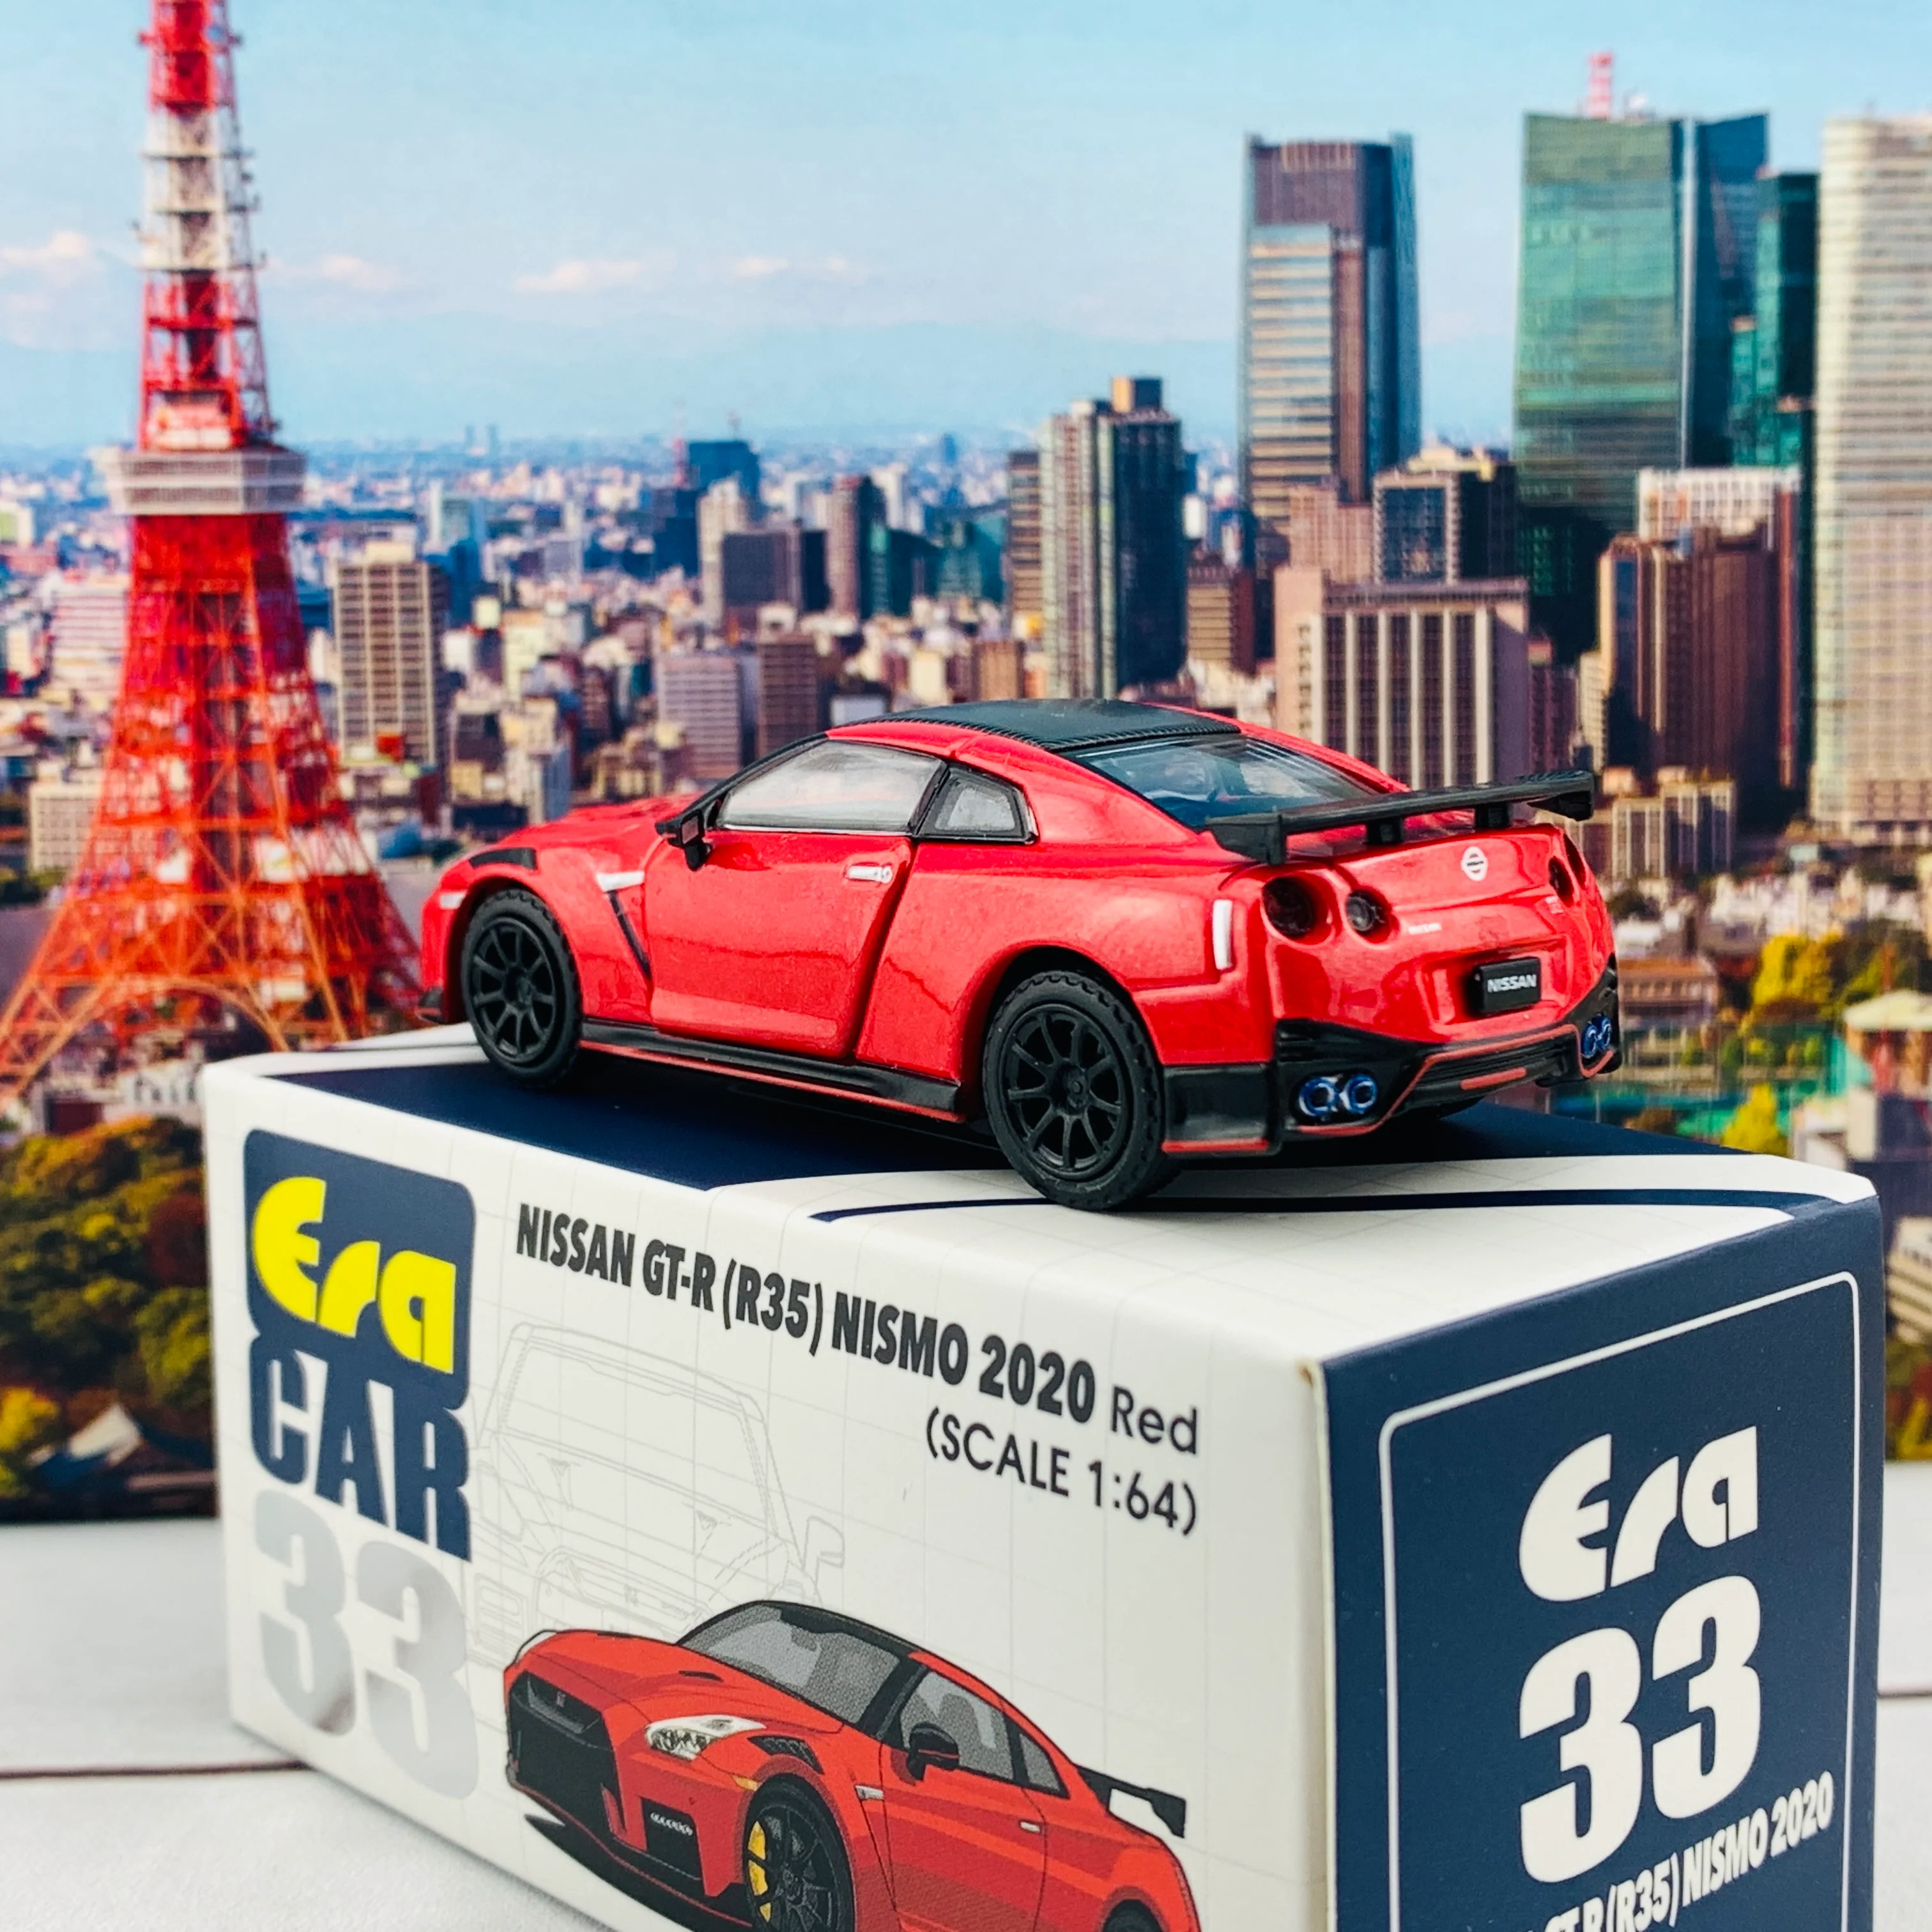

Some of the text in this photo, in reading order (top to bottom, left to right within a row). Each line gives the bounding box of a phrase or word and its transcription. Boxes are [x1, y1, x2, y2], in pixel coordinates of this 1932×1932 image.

[1487, 974, 1537, 993] NISSAN
[252, 1176, 456, 1375] Era
[517, 1204, 1197, 1455] NISSAN GT-R (R35) NISMO 2020 Red
[250, 1332, 471, 1563] CAR
[926, 1407, 1197, 1535] (SCALE 1:64)
[1519, 1425, 1758, 1602] Era
[255, 1489, 480, 1800] 33
[1519, 1575, 1761, 1883] 33
[1606, 1852, 1680, 1931] (R35)
[1683, 1807, 1768, 1907] NISMO
[1771, 1770, 1834, 1857] 2020
